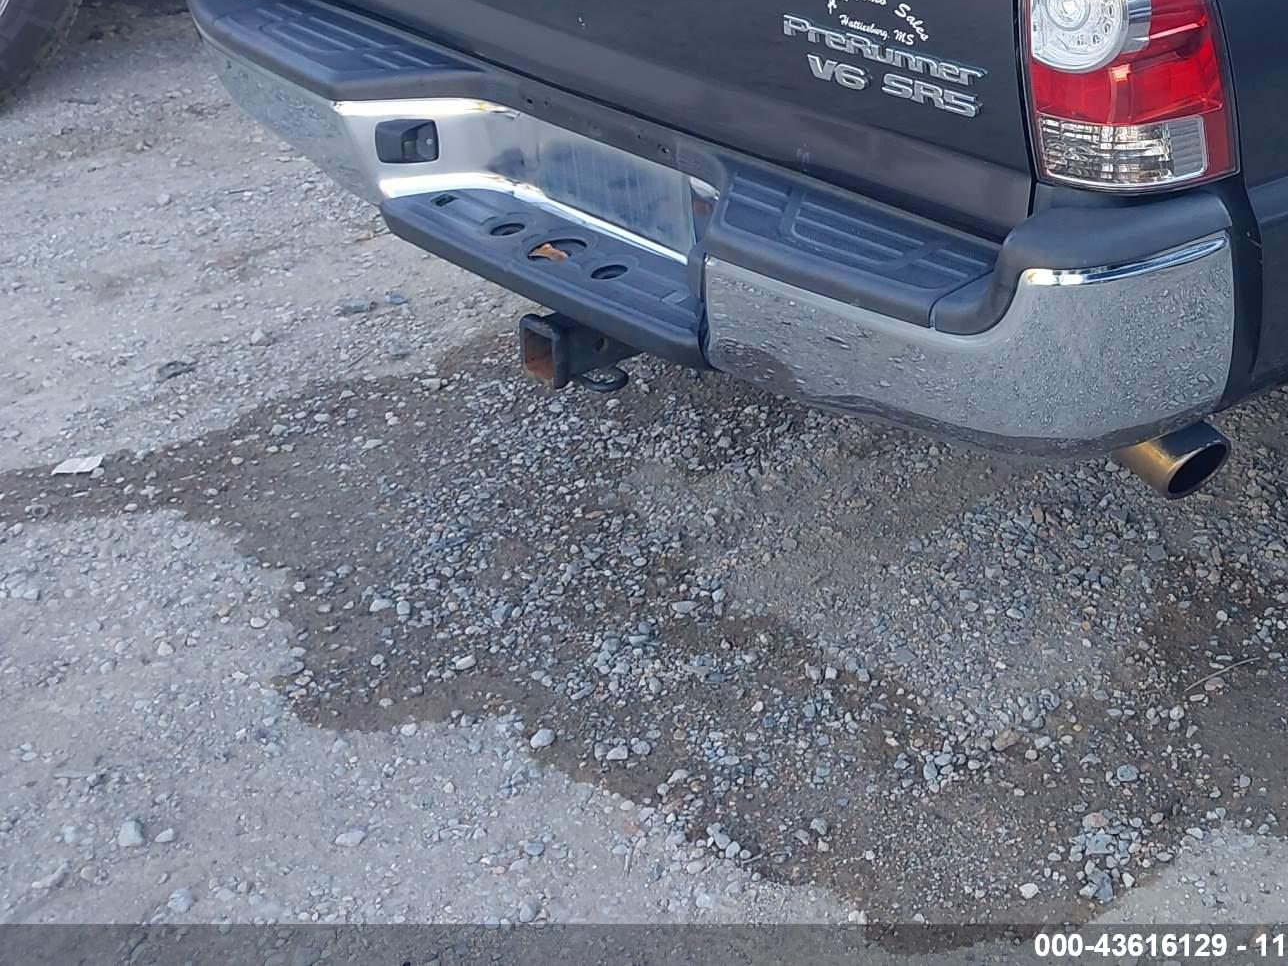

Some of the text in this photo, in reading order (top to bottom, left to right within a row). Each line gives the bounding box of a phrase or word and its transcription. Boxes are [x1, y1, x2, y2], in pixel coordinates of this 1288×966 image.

[893, 28, 915, 46] MS
[894, 3, 930, 42] Sales
[784, 14, 988, 86] PreRunner
[807, 54, 984, 118] V6 SR5
